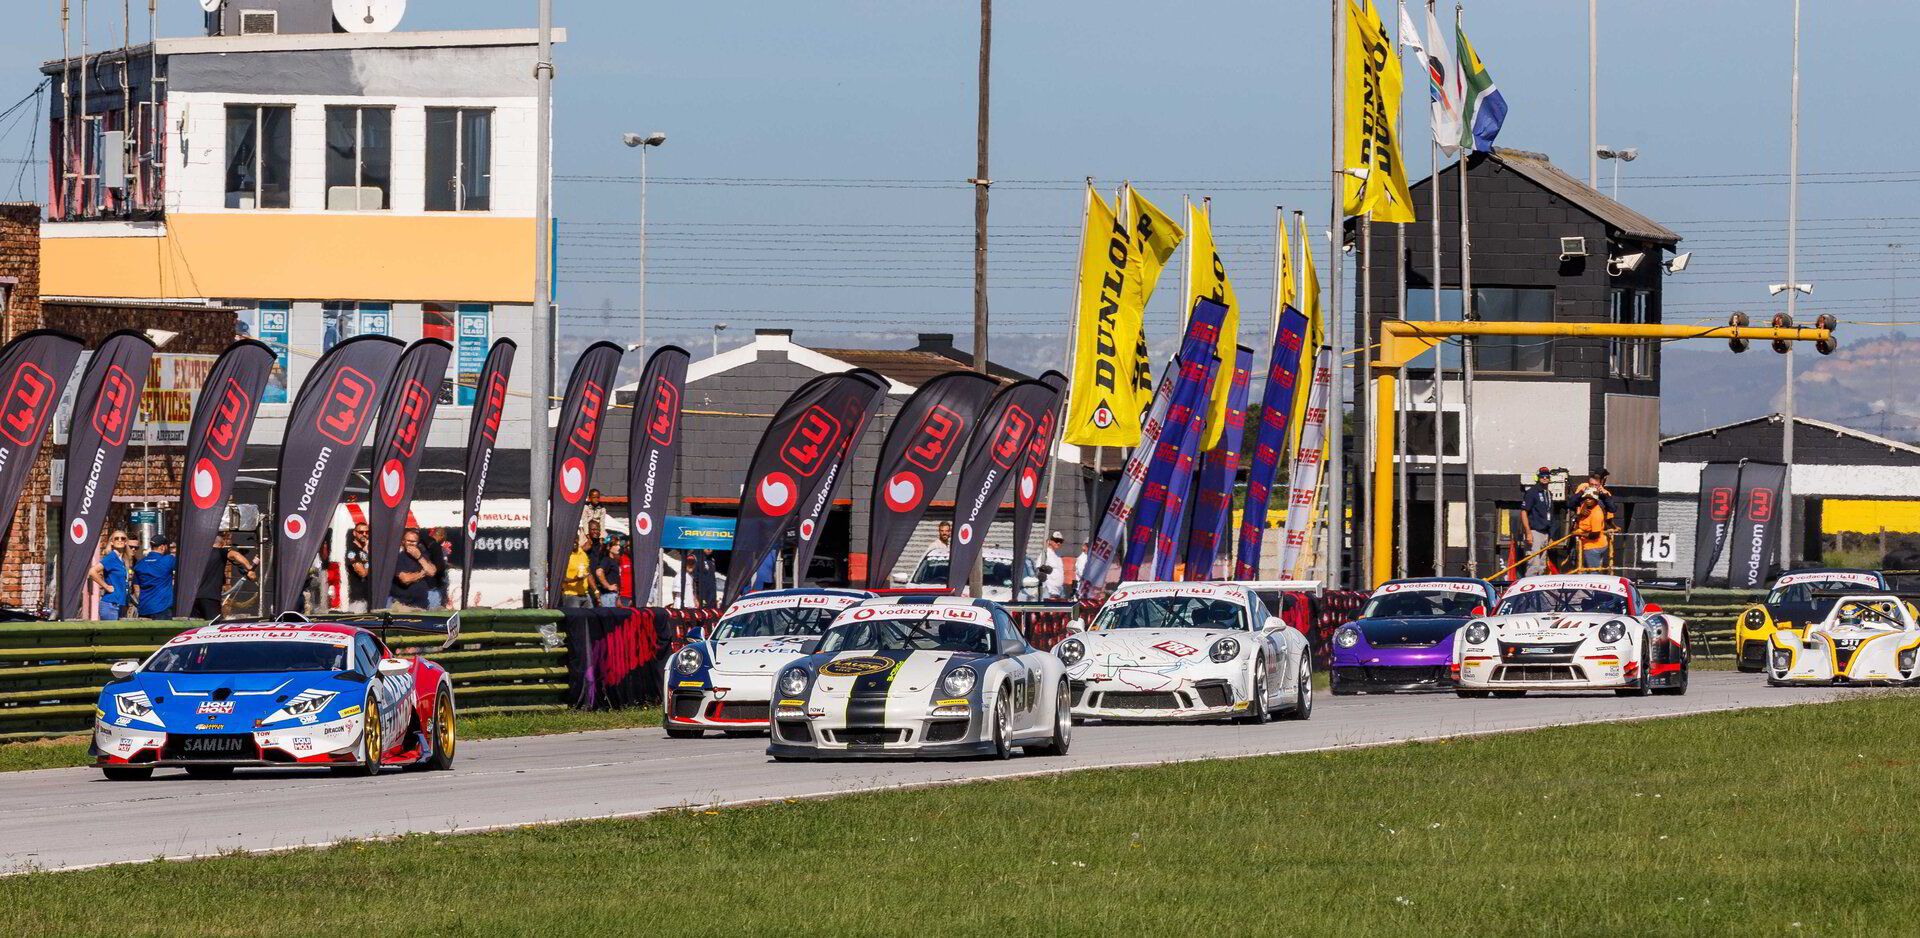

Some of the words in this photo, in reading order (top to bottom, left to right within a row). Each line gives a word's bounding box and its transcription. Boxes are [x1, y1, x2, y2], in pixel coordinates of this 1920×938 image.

[264, 313, 284, 325] PG
[364, 316, 384, 328] PG
[464, 318, 484, 330] PG
[173, 360, 208, 390] EXPRE
[8, 373, 45, 432] 4U
[140, 390, 192, 422] SERVICES
[211, 389, 241, 450] 4U
[398, 389, 424, 452] 4U
[576, 388, 601, 442] 4U
[80, 447, 106, 516] vodacom
[102, 376, 126, 432] 4U
[297, 446, 332, 512] vodacom
[325, 376, 367, 438] 4U
[474, 448, 492, 512] vodacom
[485, 382, 505, 432] 4U
[643, 449, 659, 509] vodacom
[653, 385, 671, 435] 4U
[789, 414, 830, 465] 4U
[915, 414, 953, 460] 4U
[1034, 415, 1048, 459] 4U
[969, 469, 997, 523] vodacom
[999, 414, 1026, 460] 4U
[811, 463, 838, 519] vodacom
[1714, 491, 1729, 516] 4U
[1752, 491, 1769, 516] 4U
[504, 537, 529, 552] 061
[684, 530, 735, 538] RAVENOL
[1646, 535, 1671, 560] 15
[1748, 524, 1765, 586] vodacom
[742, 598, 796, 608] vodacom
[948, 610, 973, 619] 4U
[184, 738, 243, 751] SAMLIN
[324, 726, 345, 735] DRAGON
